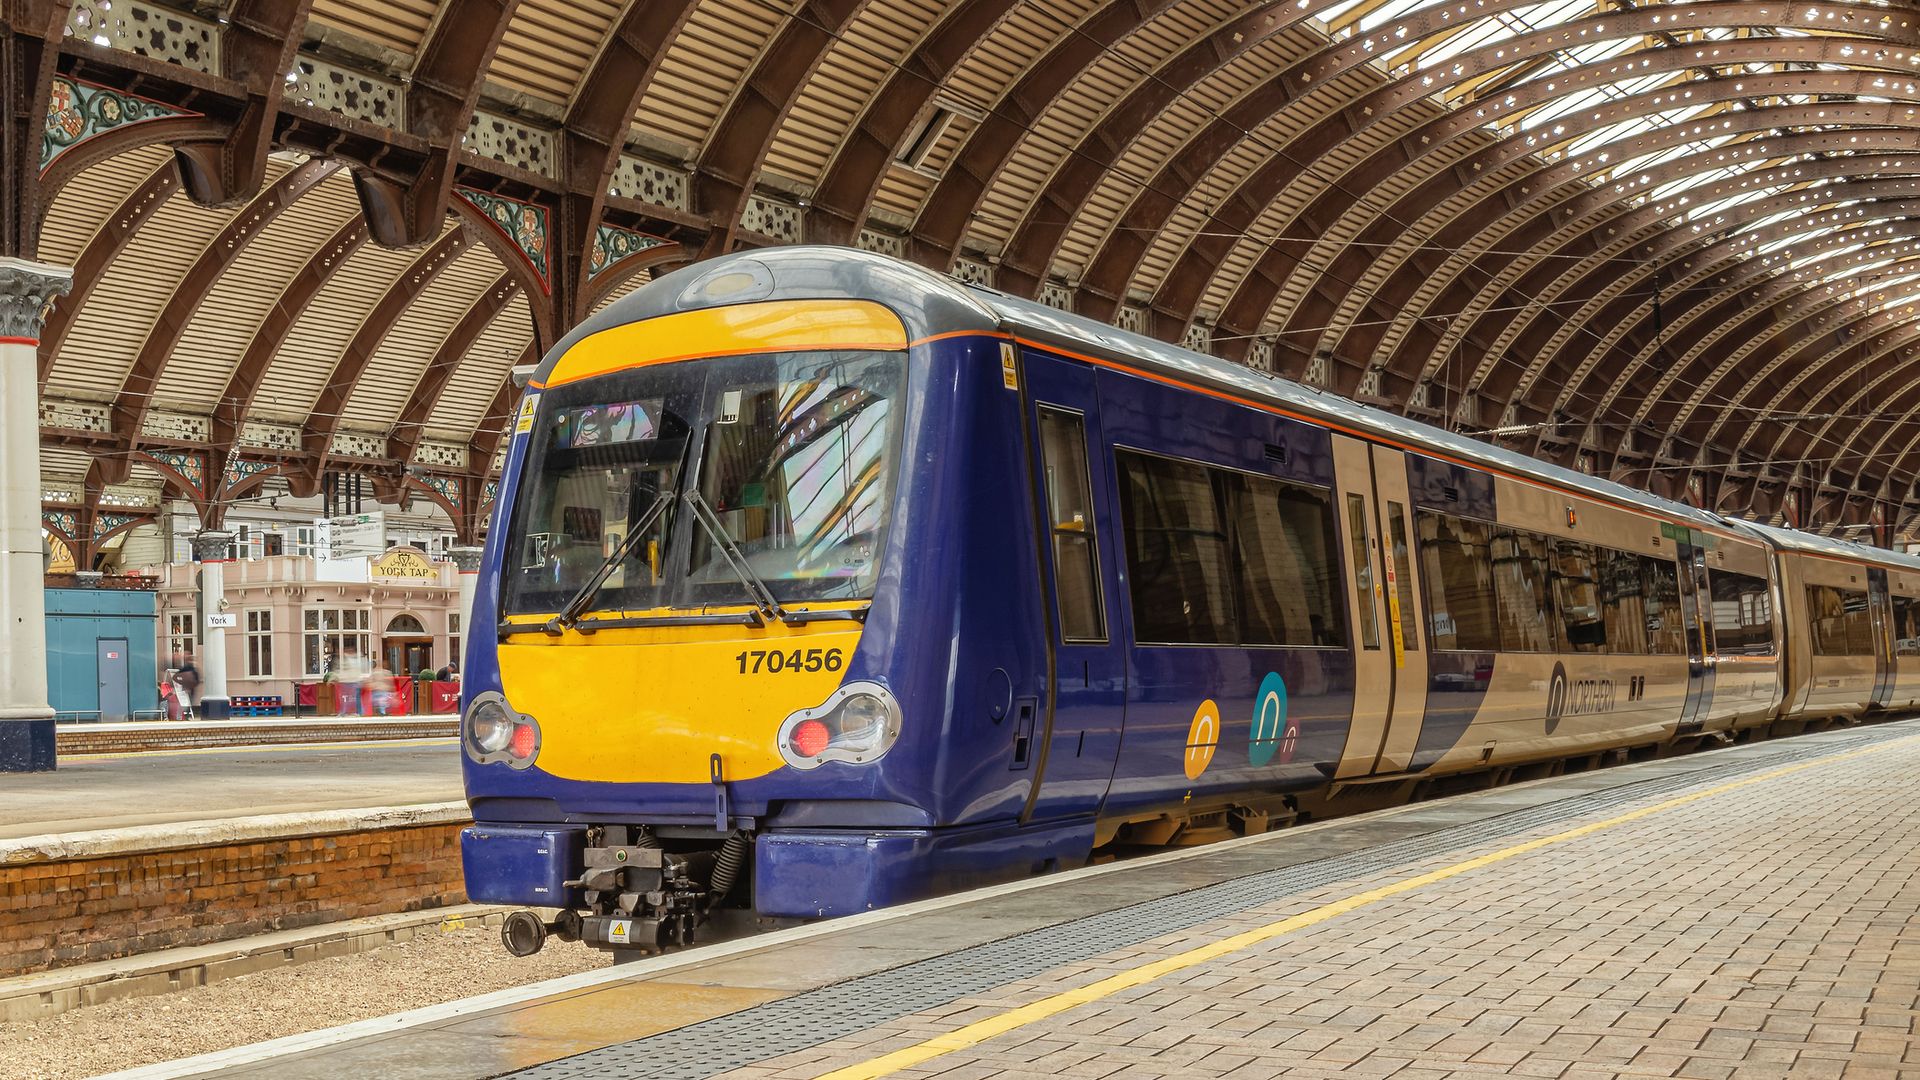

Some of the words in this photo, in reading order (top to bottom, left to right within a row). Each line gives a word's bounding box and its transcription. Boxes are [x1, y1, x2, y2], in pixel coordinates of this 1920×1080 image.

[380, 567, 406, 577] YORK
[410, 568, 429, 577] TAP
[210, 616, 227, 625] York
[736, 648, 843, 675] 170456
[1566, 680, 1617, 715] NORTHERN
